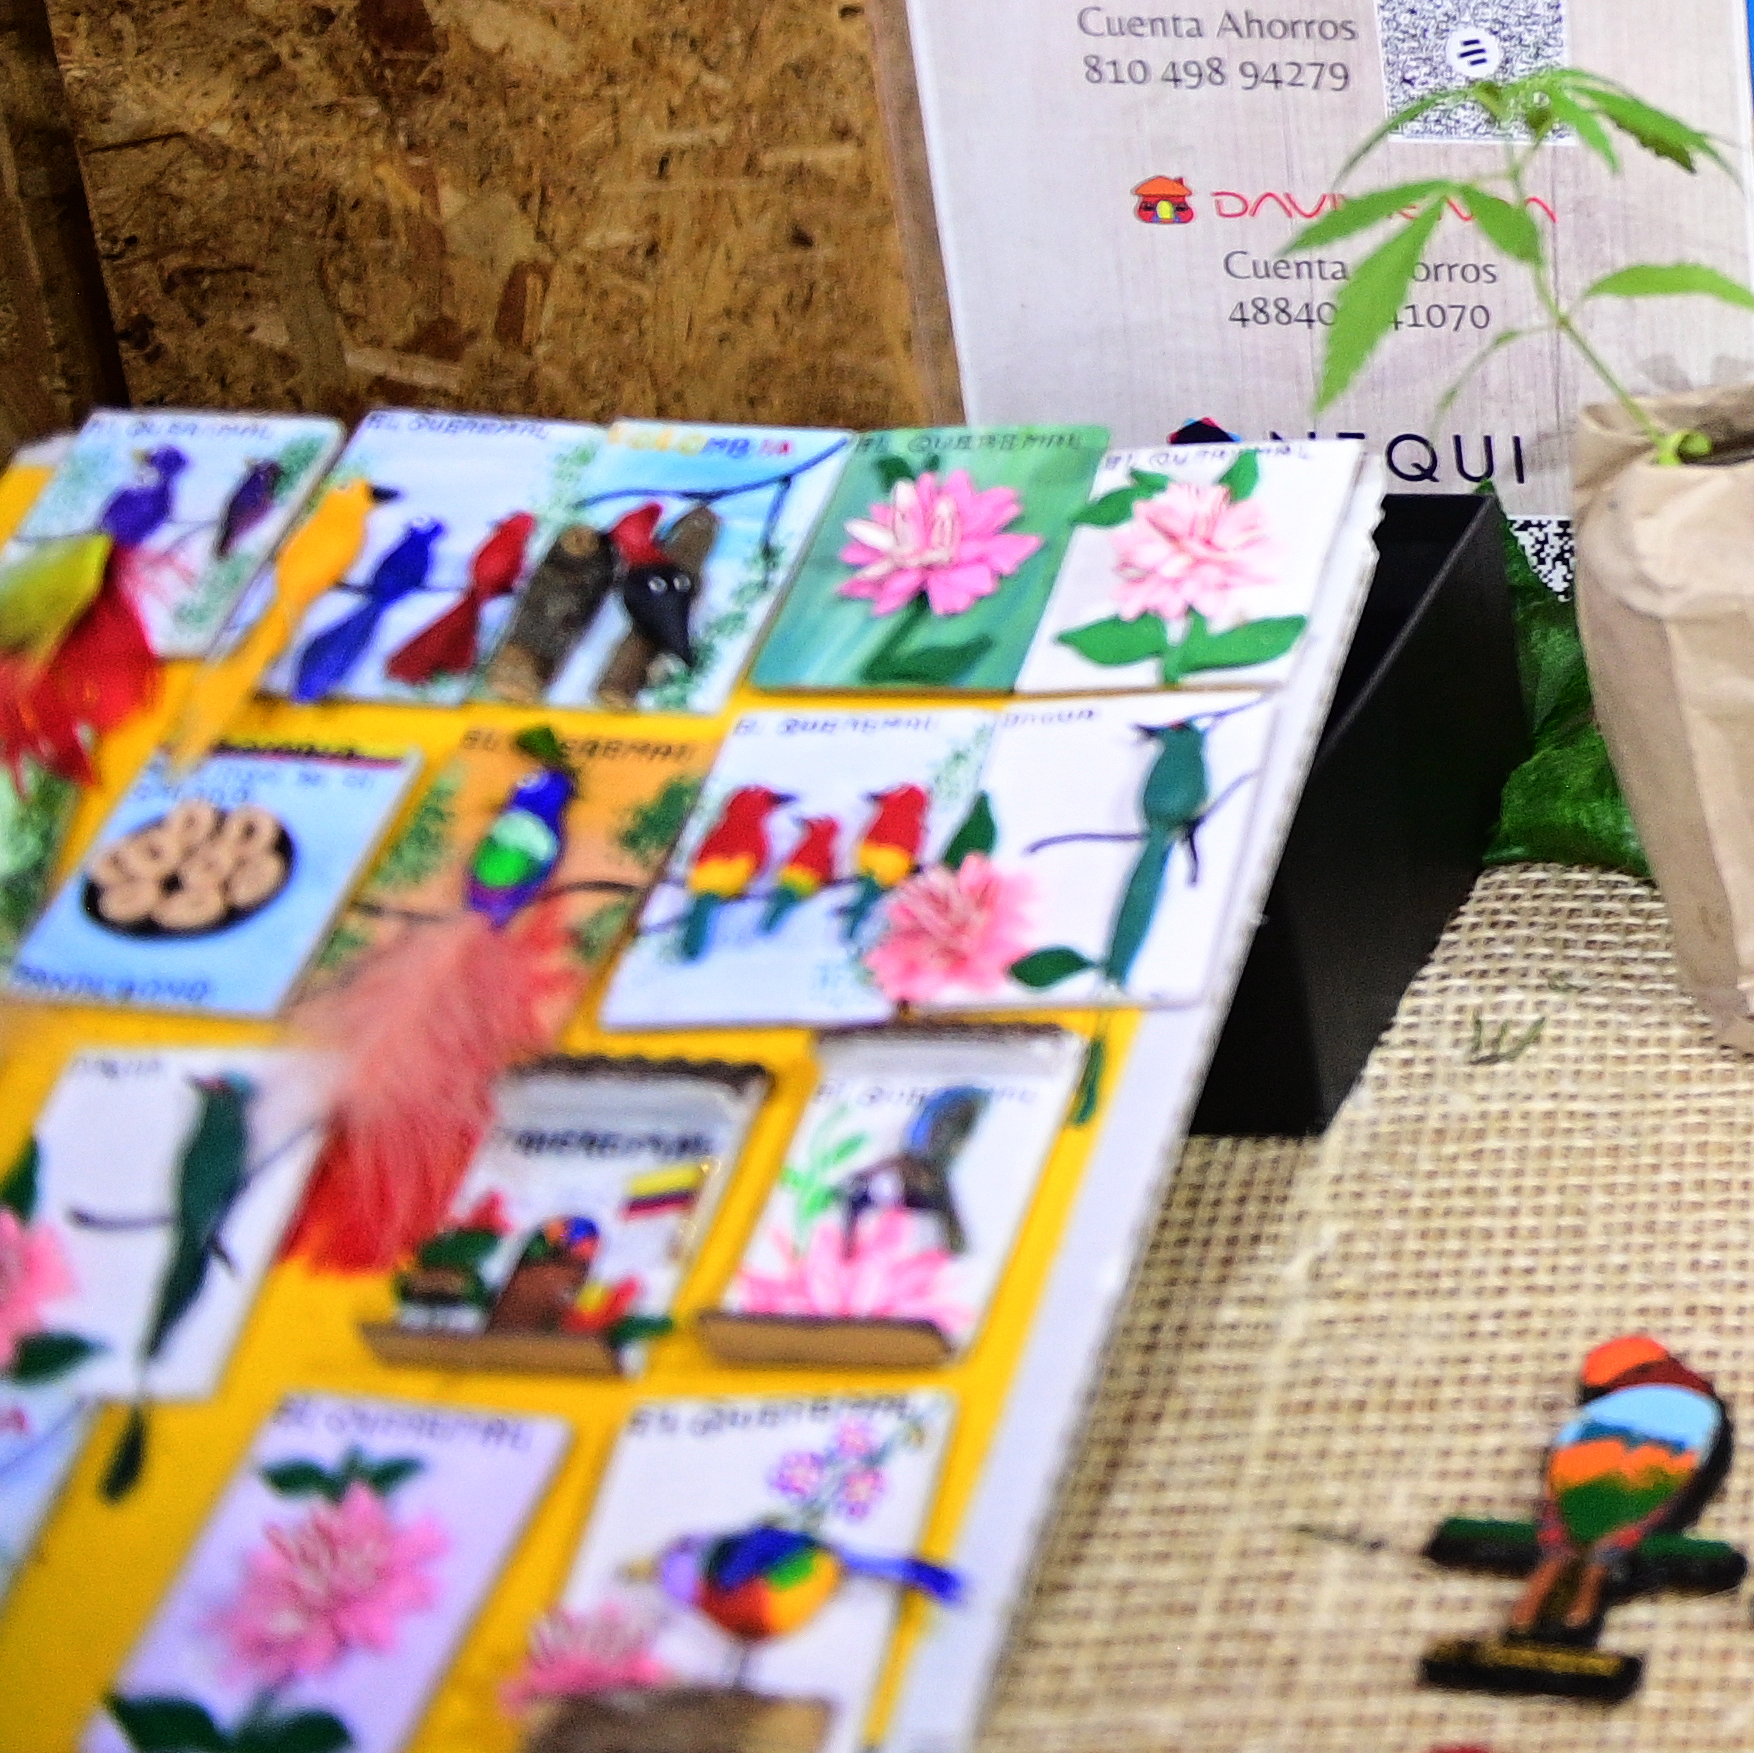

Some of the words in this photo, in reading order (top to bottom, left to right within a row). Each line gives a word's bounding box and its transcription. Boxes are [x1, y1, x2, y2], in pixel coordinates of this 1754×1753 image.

[1077, 5, 1203, 39] Cuenta
[1216, 9, 1358, 43] Ahorros
[1082, 54, 1149, 86] 810
[1160, 57, 1226, 89] 498
[1239, 60, 1351, 92] 94279
[1223, 250, 1349, 281] Cuenta
[1411, 258, 1498, 284] orros
